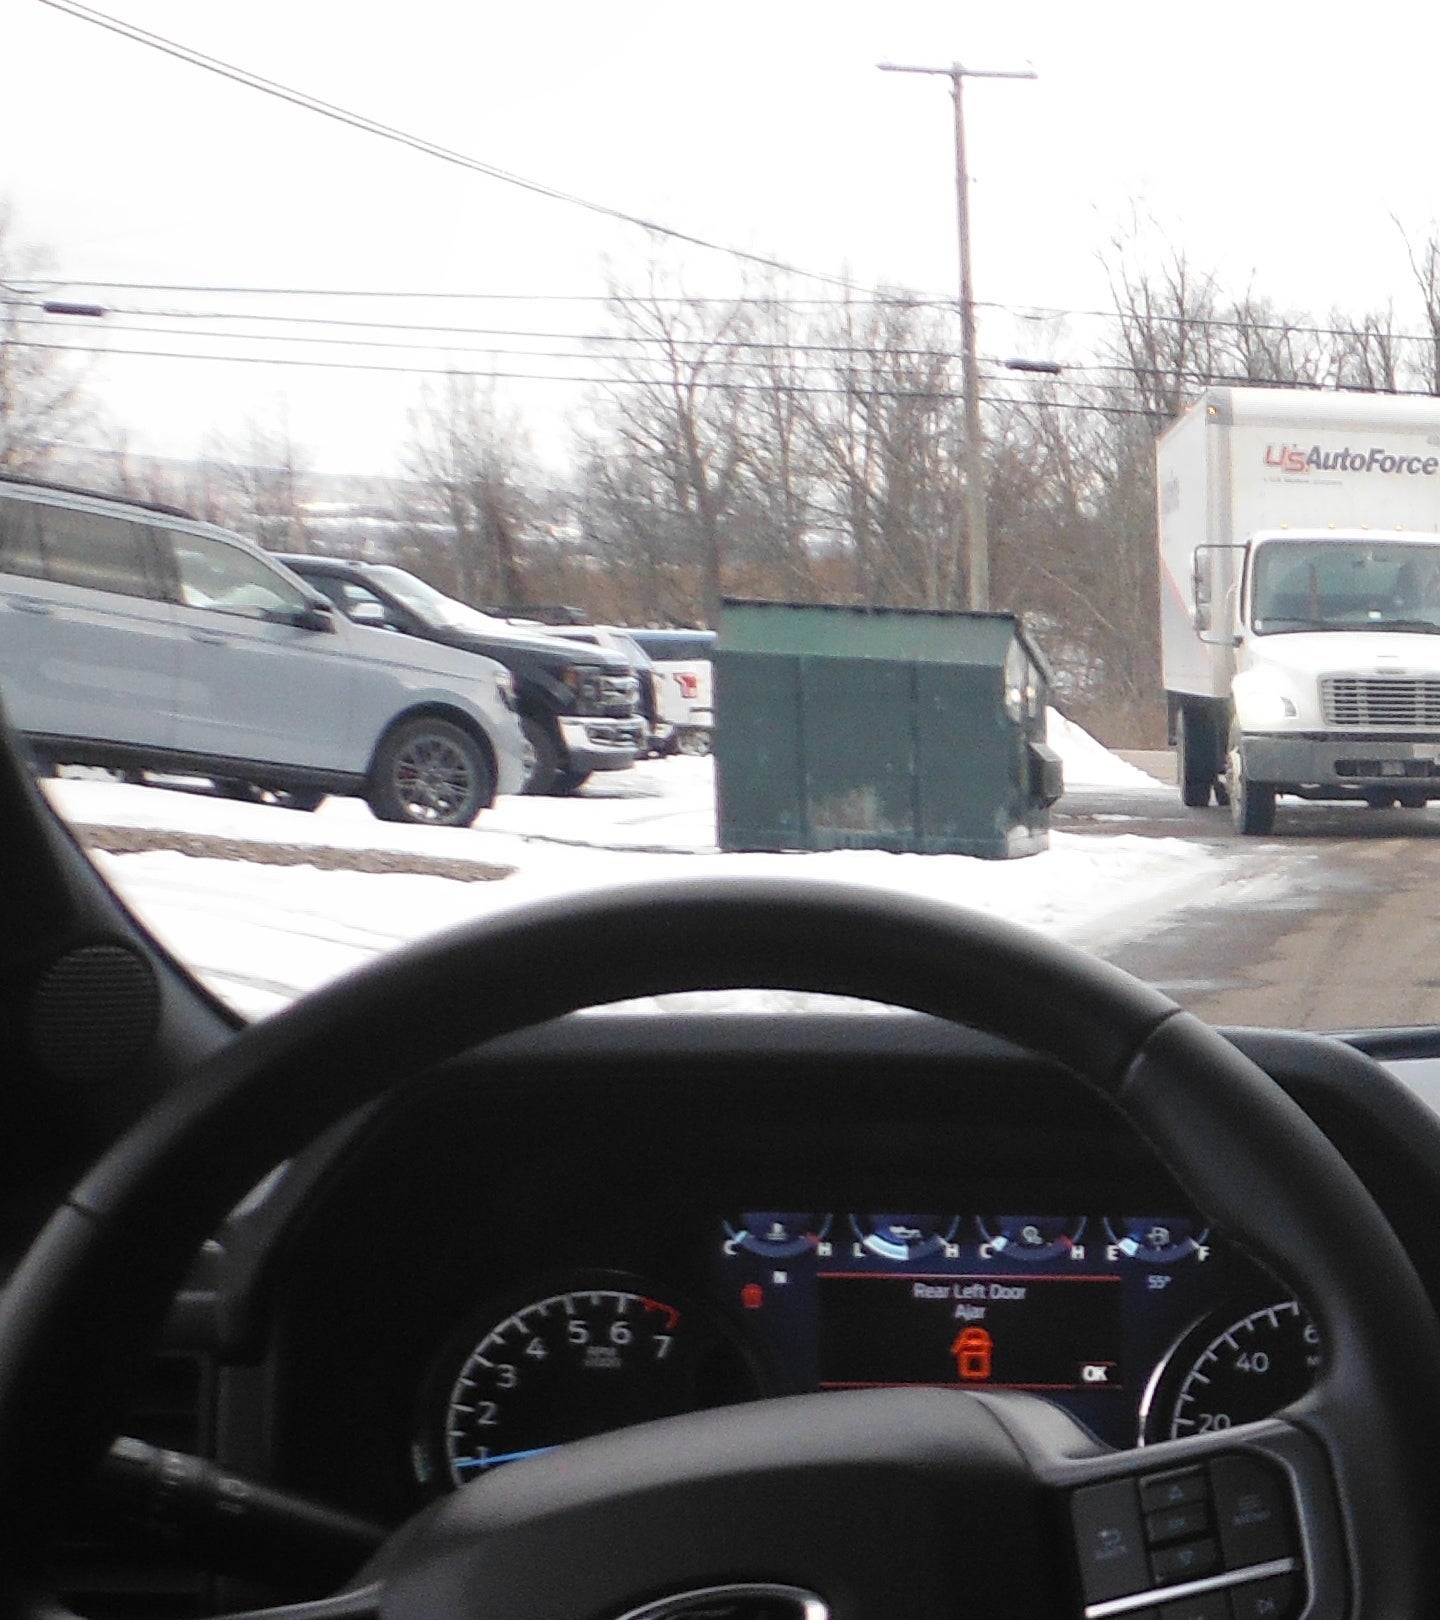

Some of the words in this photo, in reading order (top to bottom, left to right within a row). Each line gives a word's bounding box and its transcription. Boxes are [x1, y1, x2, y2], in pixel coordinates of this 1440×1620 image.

[1105, 1245, 1120, 1260] E
[1198, 1245, 1211, 1261] F
[914, 1284, 951, 1299] Rear
[954, 1284, 987, 1299] Left
[990, 1284, 1026, 1300] Door
[955, 1304, 987, 1321] Ajar
[568, 1319, 590, 1344] 5
[610, 1319, 633, 1345] 6
[525, 1336, 549, 1360] 4
[653, 1334, 674, 1359] 7
[1082, 1366, 1107, 1381] OK
[1236, 1352, 1270, 1374] 40
[496, 1363, 518, 1389] 3
[477, 1400, 498, 1425] 2
[1198, 1413, 1232, 1434] 20
